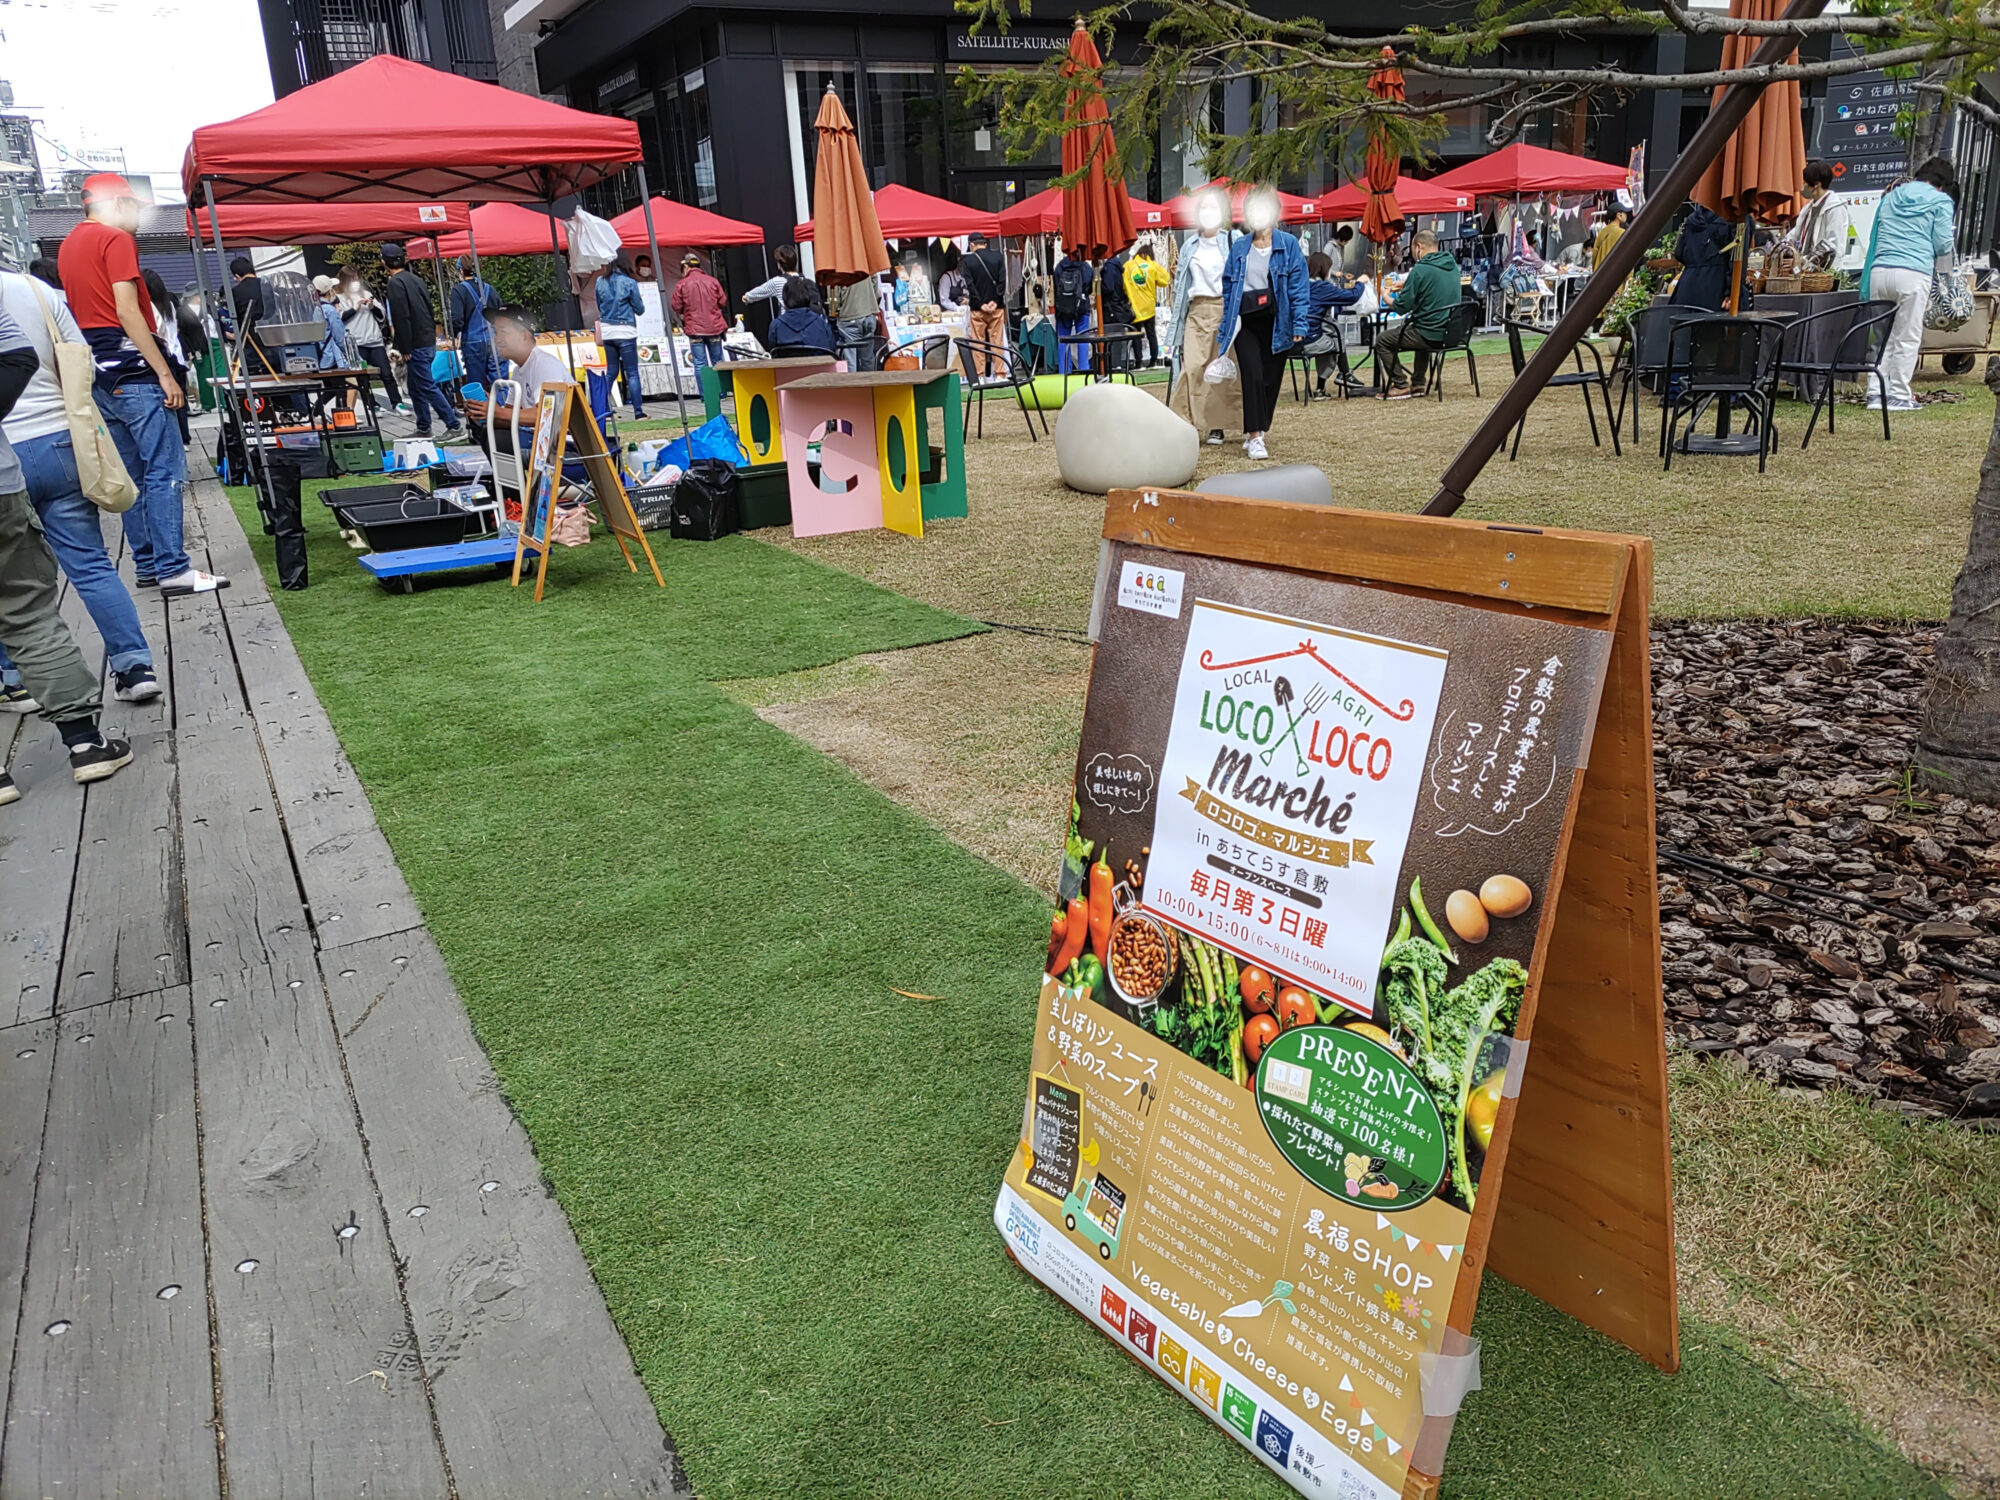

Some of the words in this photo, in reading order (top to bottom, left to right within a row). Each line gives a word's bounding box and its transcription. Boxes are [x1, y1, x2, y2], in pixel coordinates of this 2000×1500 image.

[957, 35, 1070, 49] SATELLITE-KURASH
[1852, 161, 1908, 173] 日本生命保険
[640, 494, 671, 504] TRIAL
[1224, 670, 1272, 691] LOCAL
[1332, 690, 1373, 728] AGRI
[1200, 689, 1273, 745] LOCO
[1473, 668, 1531, 800] プロデュースした
[1492, 655, 1563, 815] 倉敷の農業女子が
[1095, 764, 1142, 782] 美味しいもの
[1308, 720, 1392, 782] LOCO
[1448, 722, 1482, 795] マルシェ
[1206, 746, 1356, 835] Marché
[1206, 801, 1331, 861] ロコロコ・マルシェ
[1196, 828, 1210, 849] in
[1216, 837, 1329, 898] あちてらす倉敷
[1228, 864, 1293, 898] オープンスペース
[1189, 869, 1329, 950] 毎月第3日曜
[1049, 995, 1159, 1080] 生しぼりジュース
[1048, 1085, 1068, 1102] Menu
[1298, 1033, 1425, 1117] PRESENT
[1286, 1131, 1340, 1172] プレゼント!
[1006, 1217, 1039, 1255] GOALS
[1302, 1206, 1433, 1294] 農福SHOP
[1302, 1242, 1357, 1286] 野菜・花
[1299, 1261, 1418, 1345] ハンドメイド焼き菓子
[1131, 1260, 1216, 1335] Vegetable
[1233, 1336, 1300, 1397] Cheese
[1321, 1400, 1373, 1453] Eggs
[1292, 1460, 1322, 1488] 倉敷市
